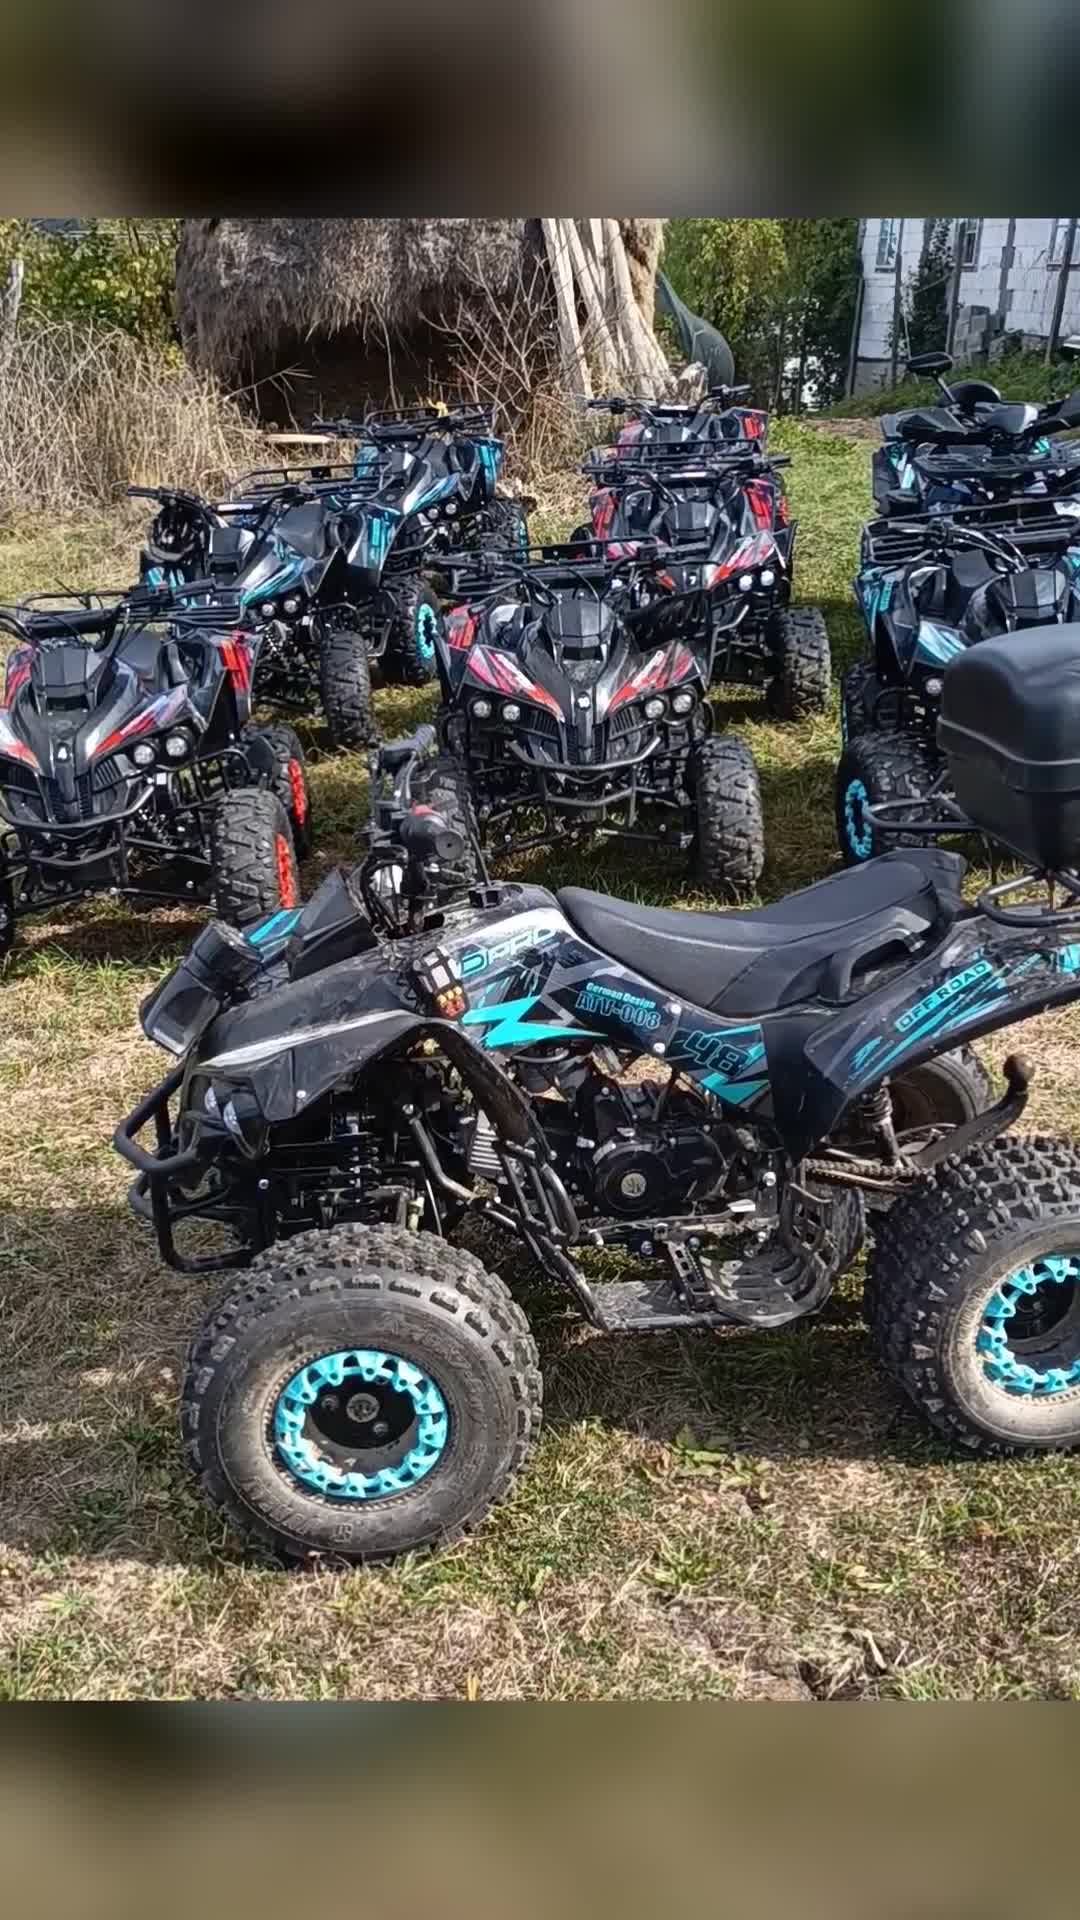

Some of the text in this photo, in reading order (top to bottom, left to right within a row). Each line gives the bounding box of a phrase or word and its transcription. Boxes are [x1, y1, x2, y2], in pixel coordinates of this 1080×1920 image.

[575, 990, 661, 1030] ATV-008
[586, 982, 623, 1000] German
[899, 996, 934, 1028] OFF
[936, 963, 986, 999] ROAD
[683, 1030, 753, 1077] 48
